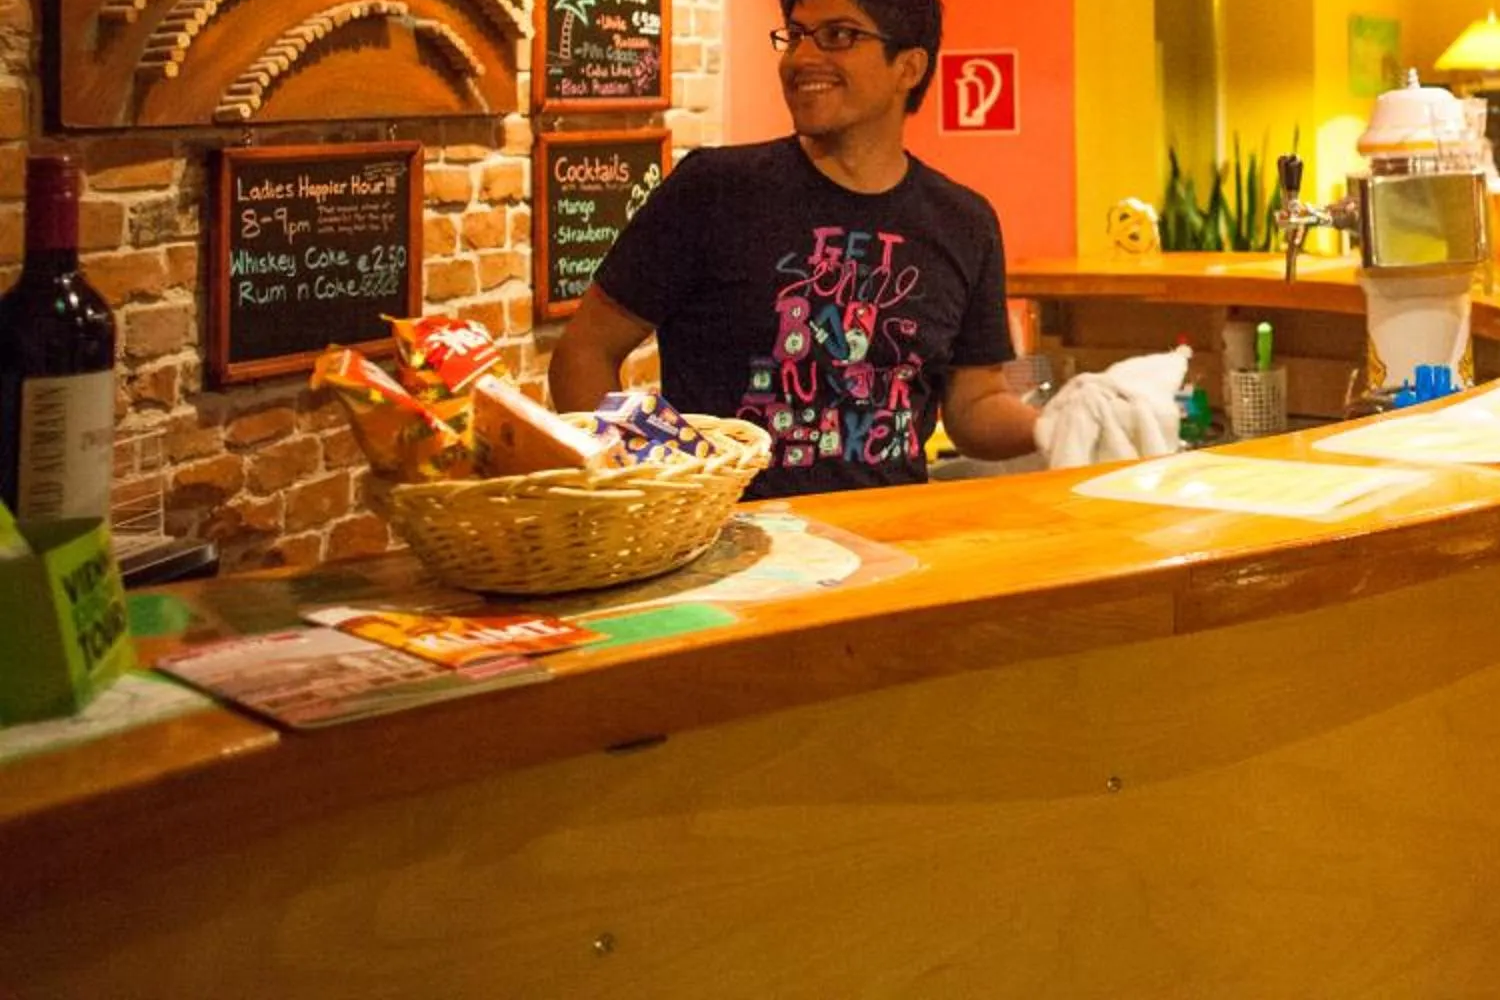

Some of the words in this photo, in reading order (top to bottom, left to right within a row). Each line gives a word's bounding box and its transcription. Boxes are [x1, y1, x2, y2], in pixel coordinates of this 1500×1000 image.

[554, 153, 630, 183] Cocktails
[237, 176, 294, 202] Ladies
[298, 172, 347, 204] Happier
[557, 198, 596, 223] Mango
[228, 249, 297, 278] Whiskey
[304, 246, 351, 270] Coke
[238, 281, 288, 307] Rum
[314, 275, 360, 299] Coke
